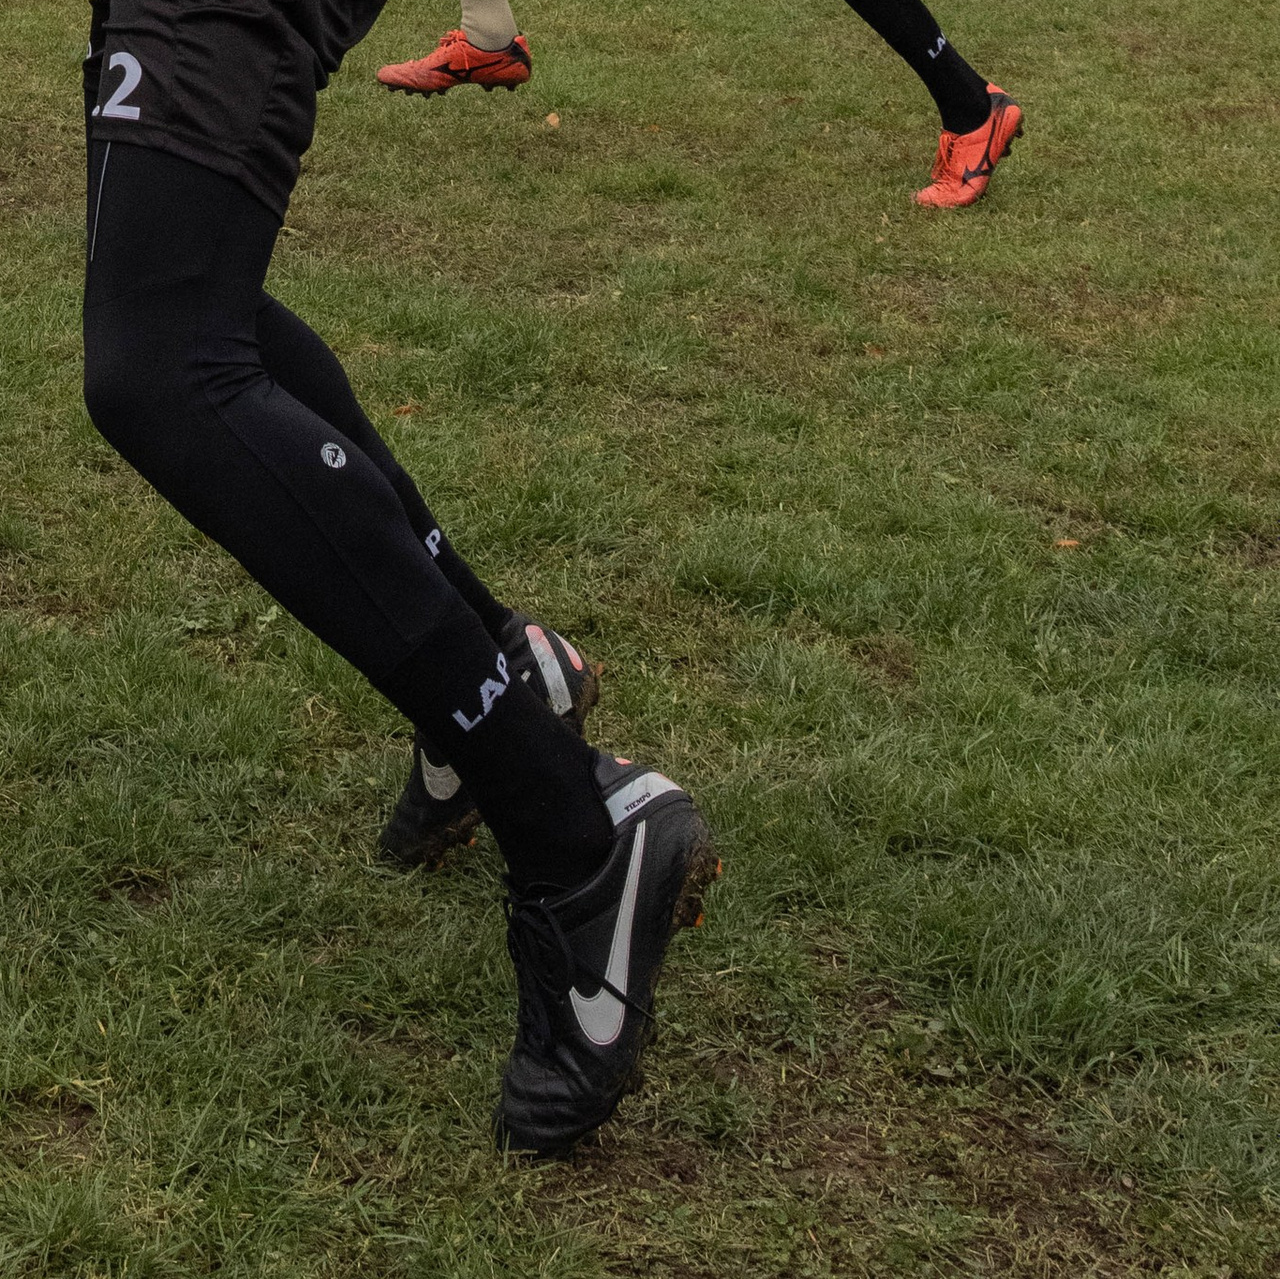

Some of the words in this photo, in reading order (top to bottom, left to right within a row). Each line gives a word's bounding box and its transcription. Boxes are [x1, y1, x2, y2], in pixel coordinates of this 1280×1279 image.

[92, 51, 143, 120] 2
[452, 652, 511, 732] LAP
[624, 792, 652, 812] TIEMPO
